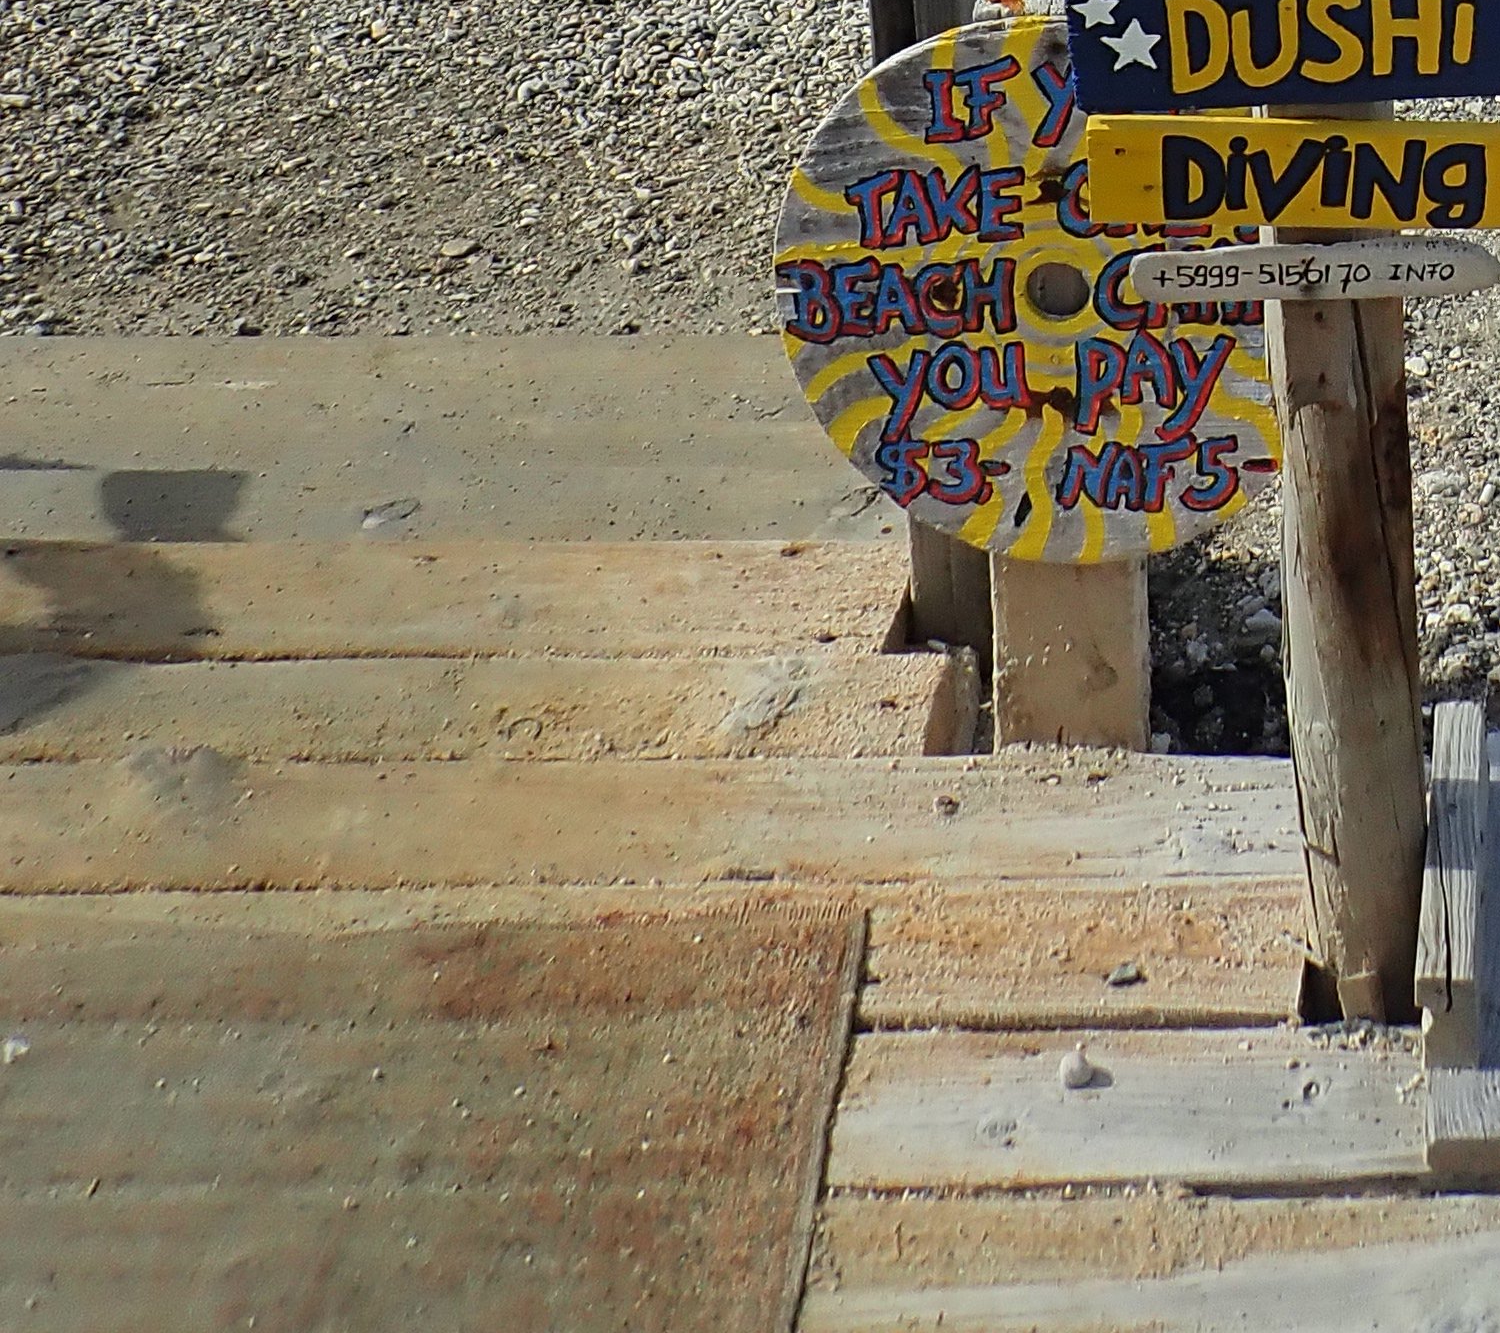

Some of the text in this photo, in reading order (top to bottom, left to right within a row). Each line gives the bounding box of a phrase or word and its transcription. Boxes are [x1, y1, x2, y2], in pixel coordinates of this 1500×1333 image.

[924, 55, 1020, 145] IF
[845, 165, 1026, 249] TAKE
[779, 255, 1020, 341] BEACH
[1388, 262, 1456, 283] INFO
[870, 331, 1235, 443] YOU PAY
